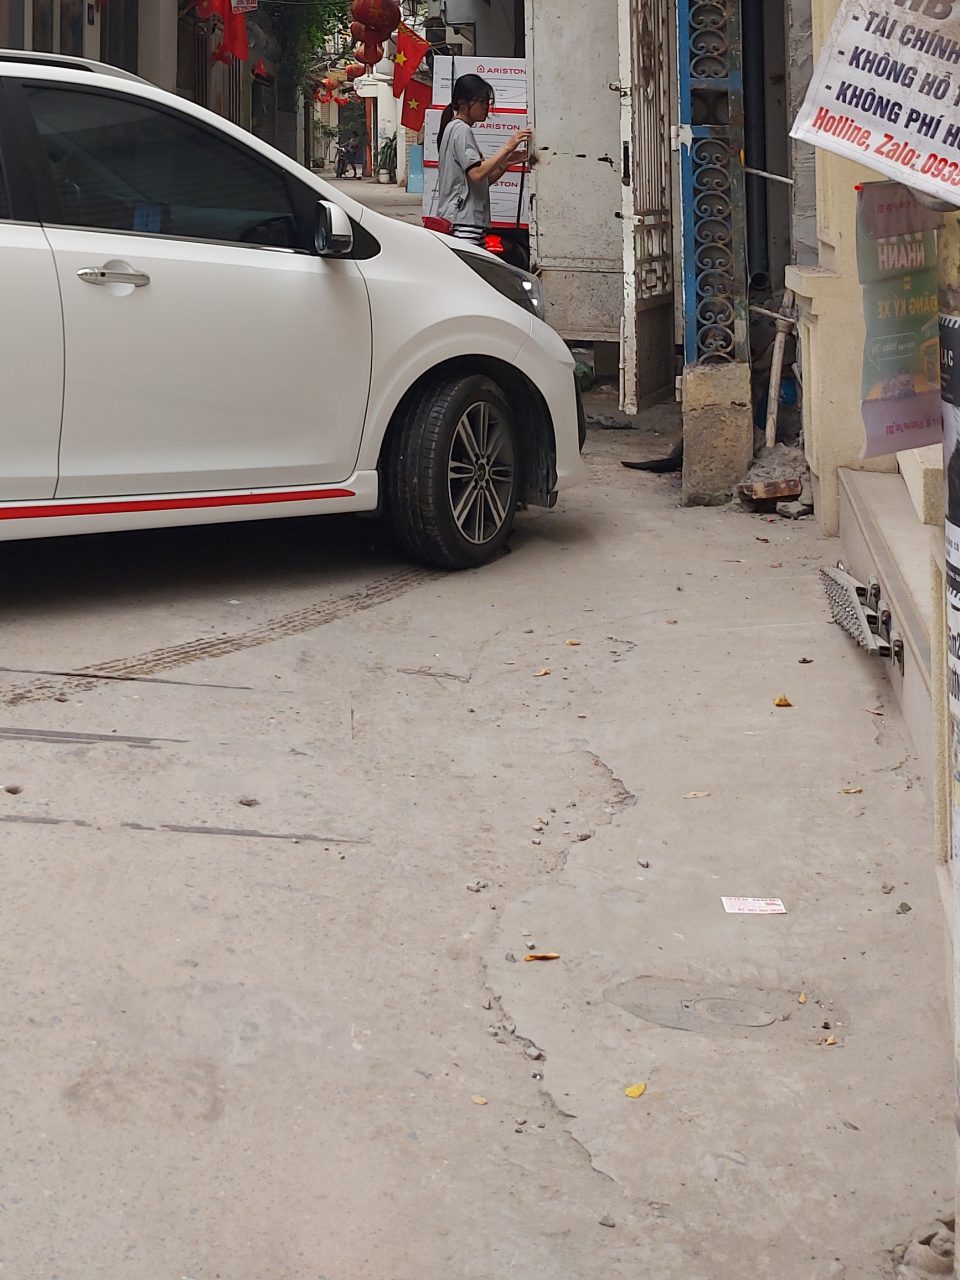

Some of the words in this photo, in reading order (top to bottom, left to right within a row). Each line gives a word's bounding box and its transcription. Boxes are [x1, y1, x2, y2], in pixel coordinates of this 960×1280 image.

[863, 11, 895, 40] TÀI
[487, 67, 527, 75] ARISTON
[848, 45, 918, 90] KHÔNG
[918, 71, 953, 101] HỖ
[811, 106, 872, 152] Hotline,
[873, 132, 922, 169] Zalo:
[835, 80, 903, 125] KHÔNG
[904, 107, 945, 140] PHÍ
